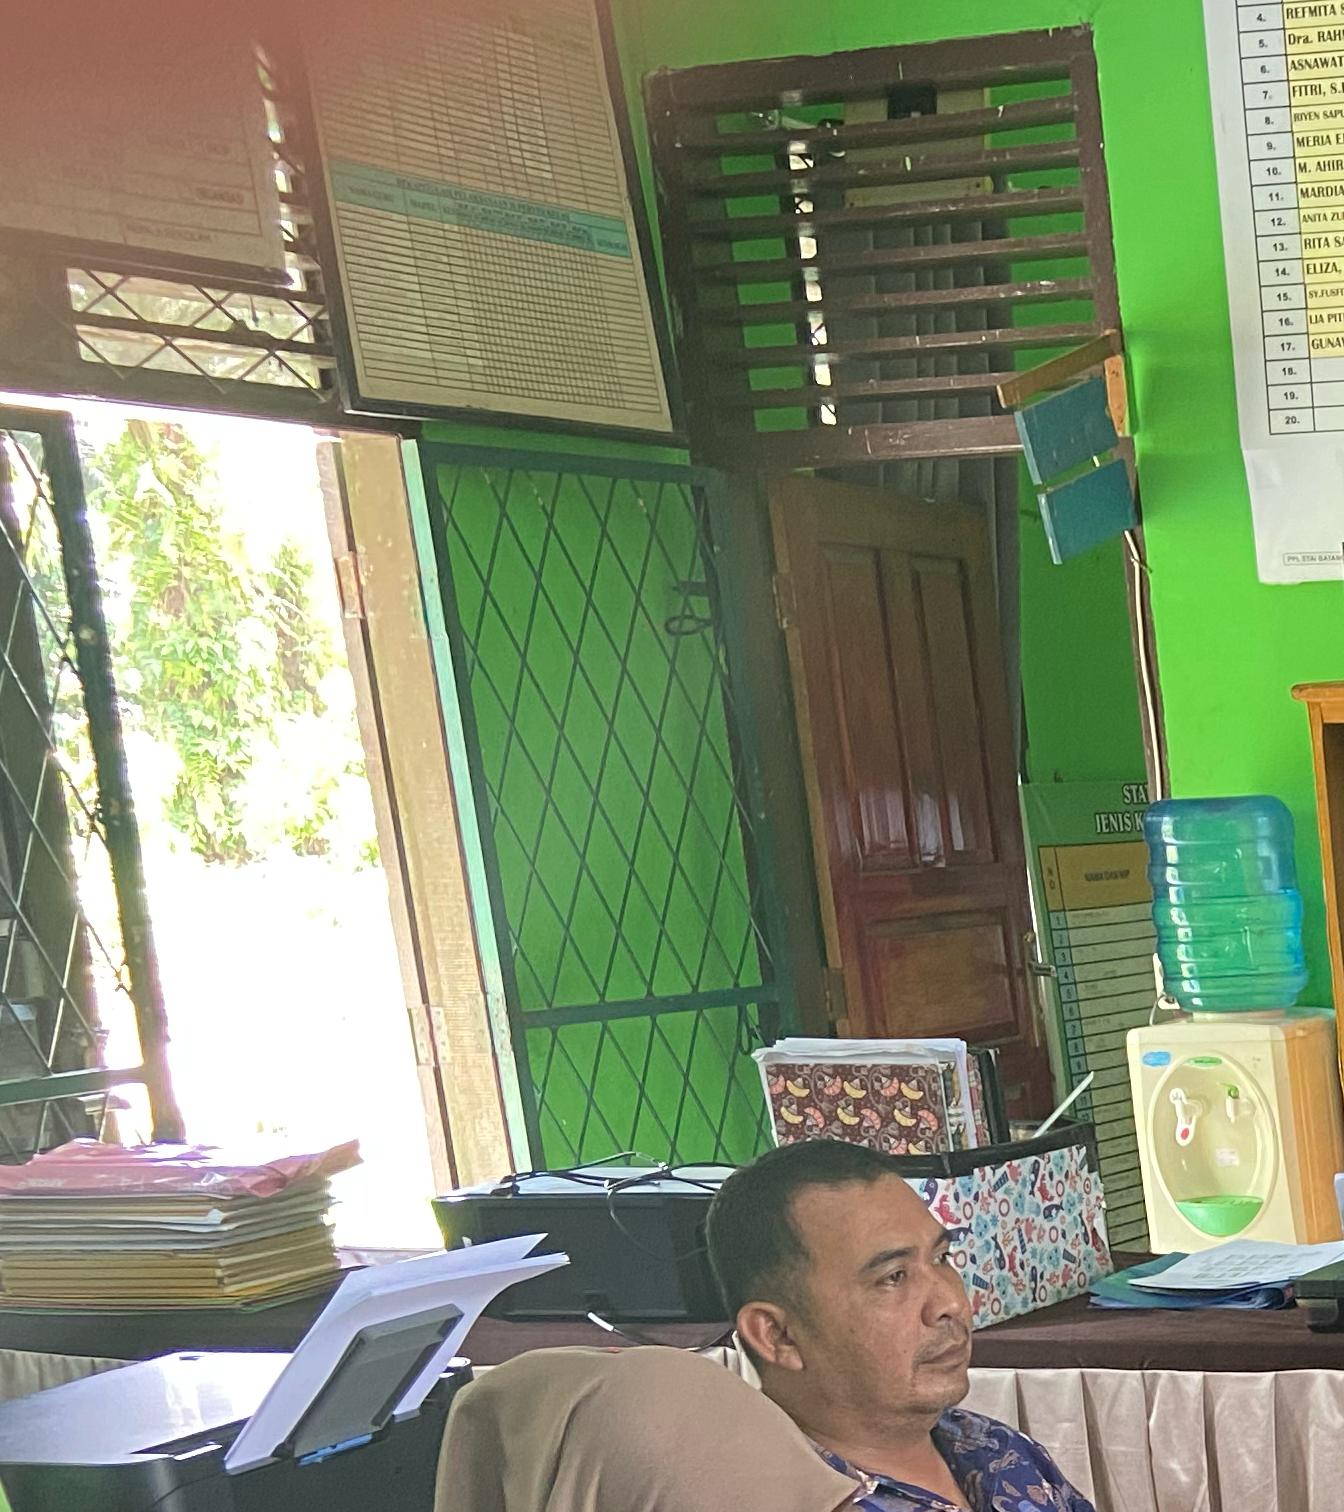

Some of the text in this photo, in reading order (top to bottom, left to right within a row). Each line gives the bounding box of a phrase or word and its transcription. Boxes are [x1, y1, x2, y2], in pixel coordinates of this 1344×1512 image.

[1288, 32, 1314, 45] Dra.
[1292, 84, 1327, 98] FITRI,
[1298, 160, 1311, 174] M.
[1303, 236, 1330, 250] RITA
[1306, 261, 1342, 275] ELIZA,
[1281, 342, 1295, 351] 17.
[1123, 784, 1148, 804] STA
